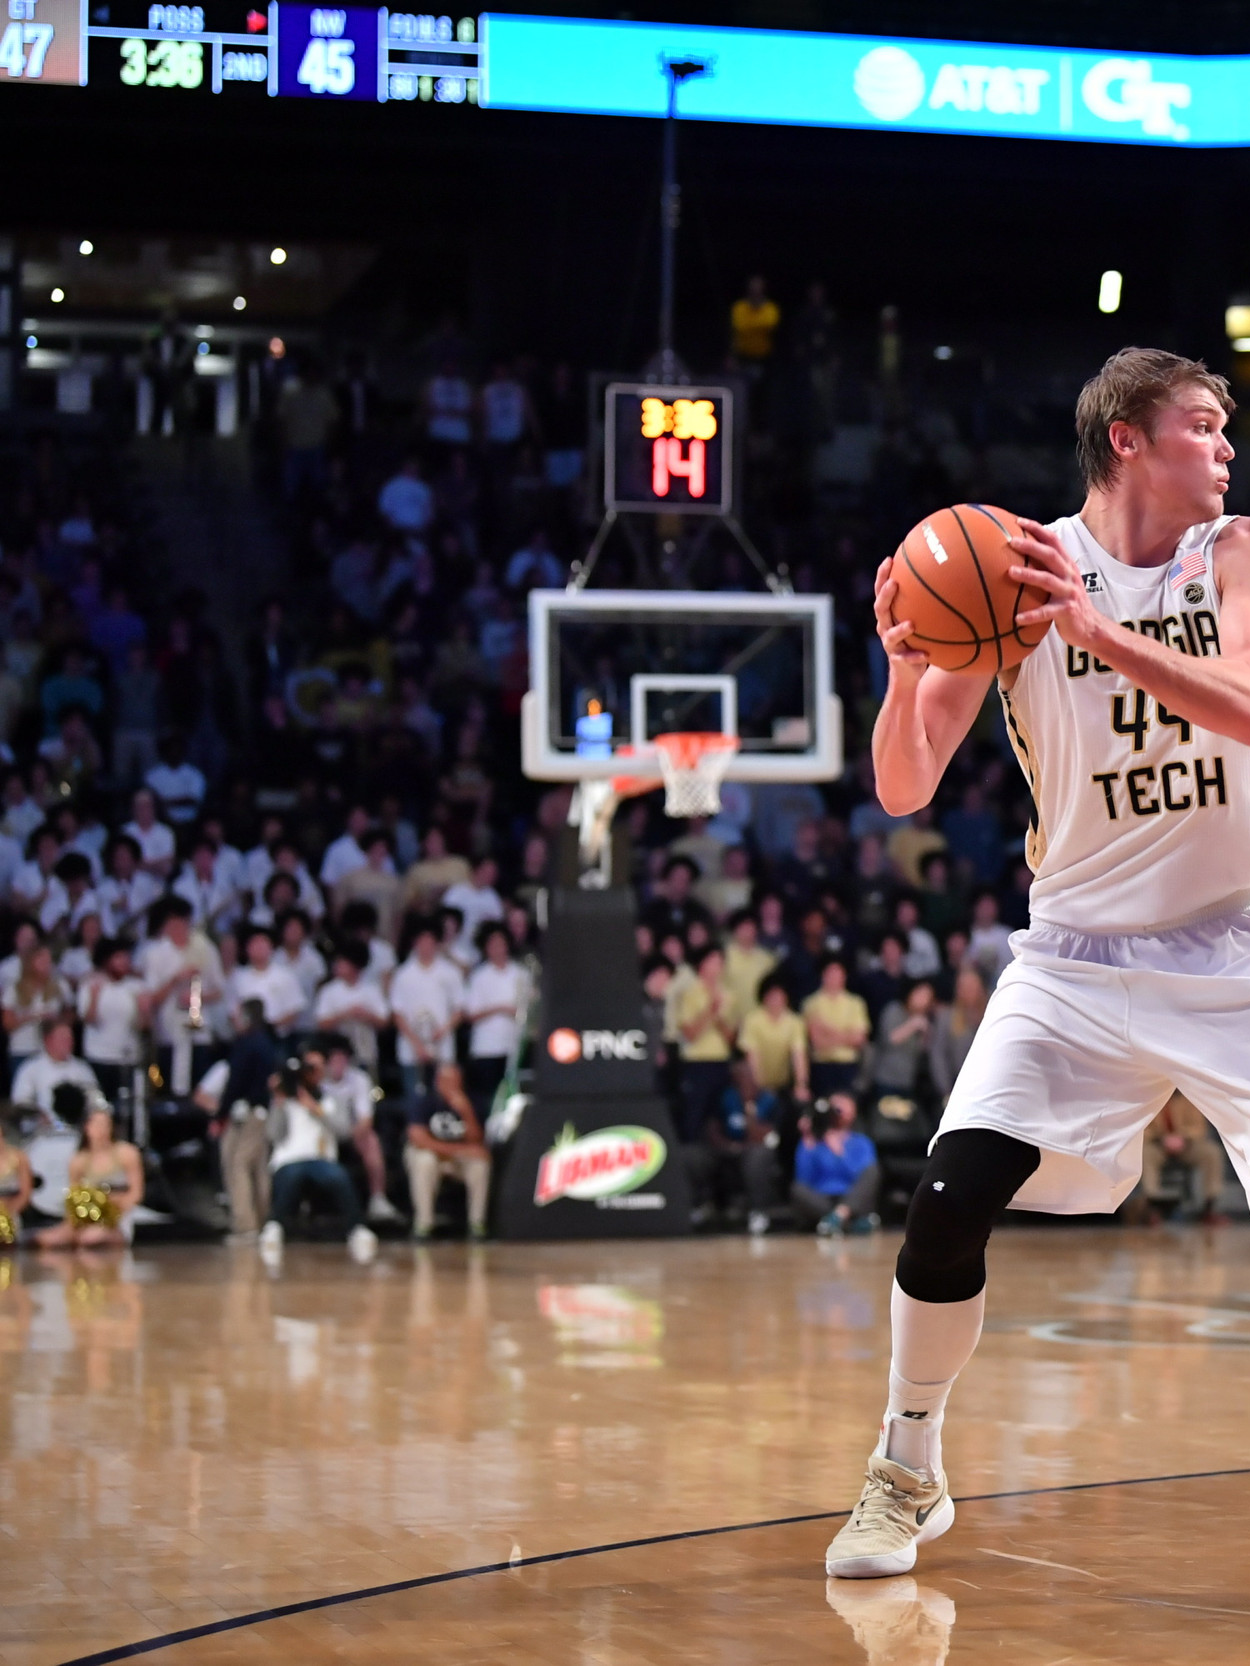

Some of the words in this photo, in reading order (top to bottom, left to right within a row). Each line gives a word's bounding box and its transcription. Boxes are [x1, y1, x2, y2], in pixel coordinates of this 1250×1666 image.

[0, 22, 54, 78] 47
[120, 38, 203, 89] 3:36
[297, 38, 355, 94] 45
[928, 64, 1049, 115] AT&T
[652, 437, 706, 498] 14
[1091, 756, 1228, 820] TECH
[582, 1029, 648, 1060] PNC
